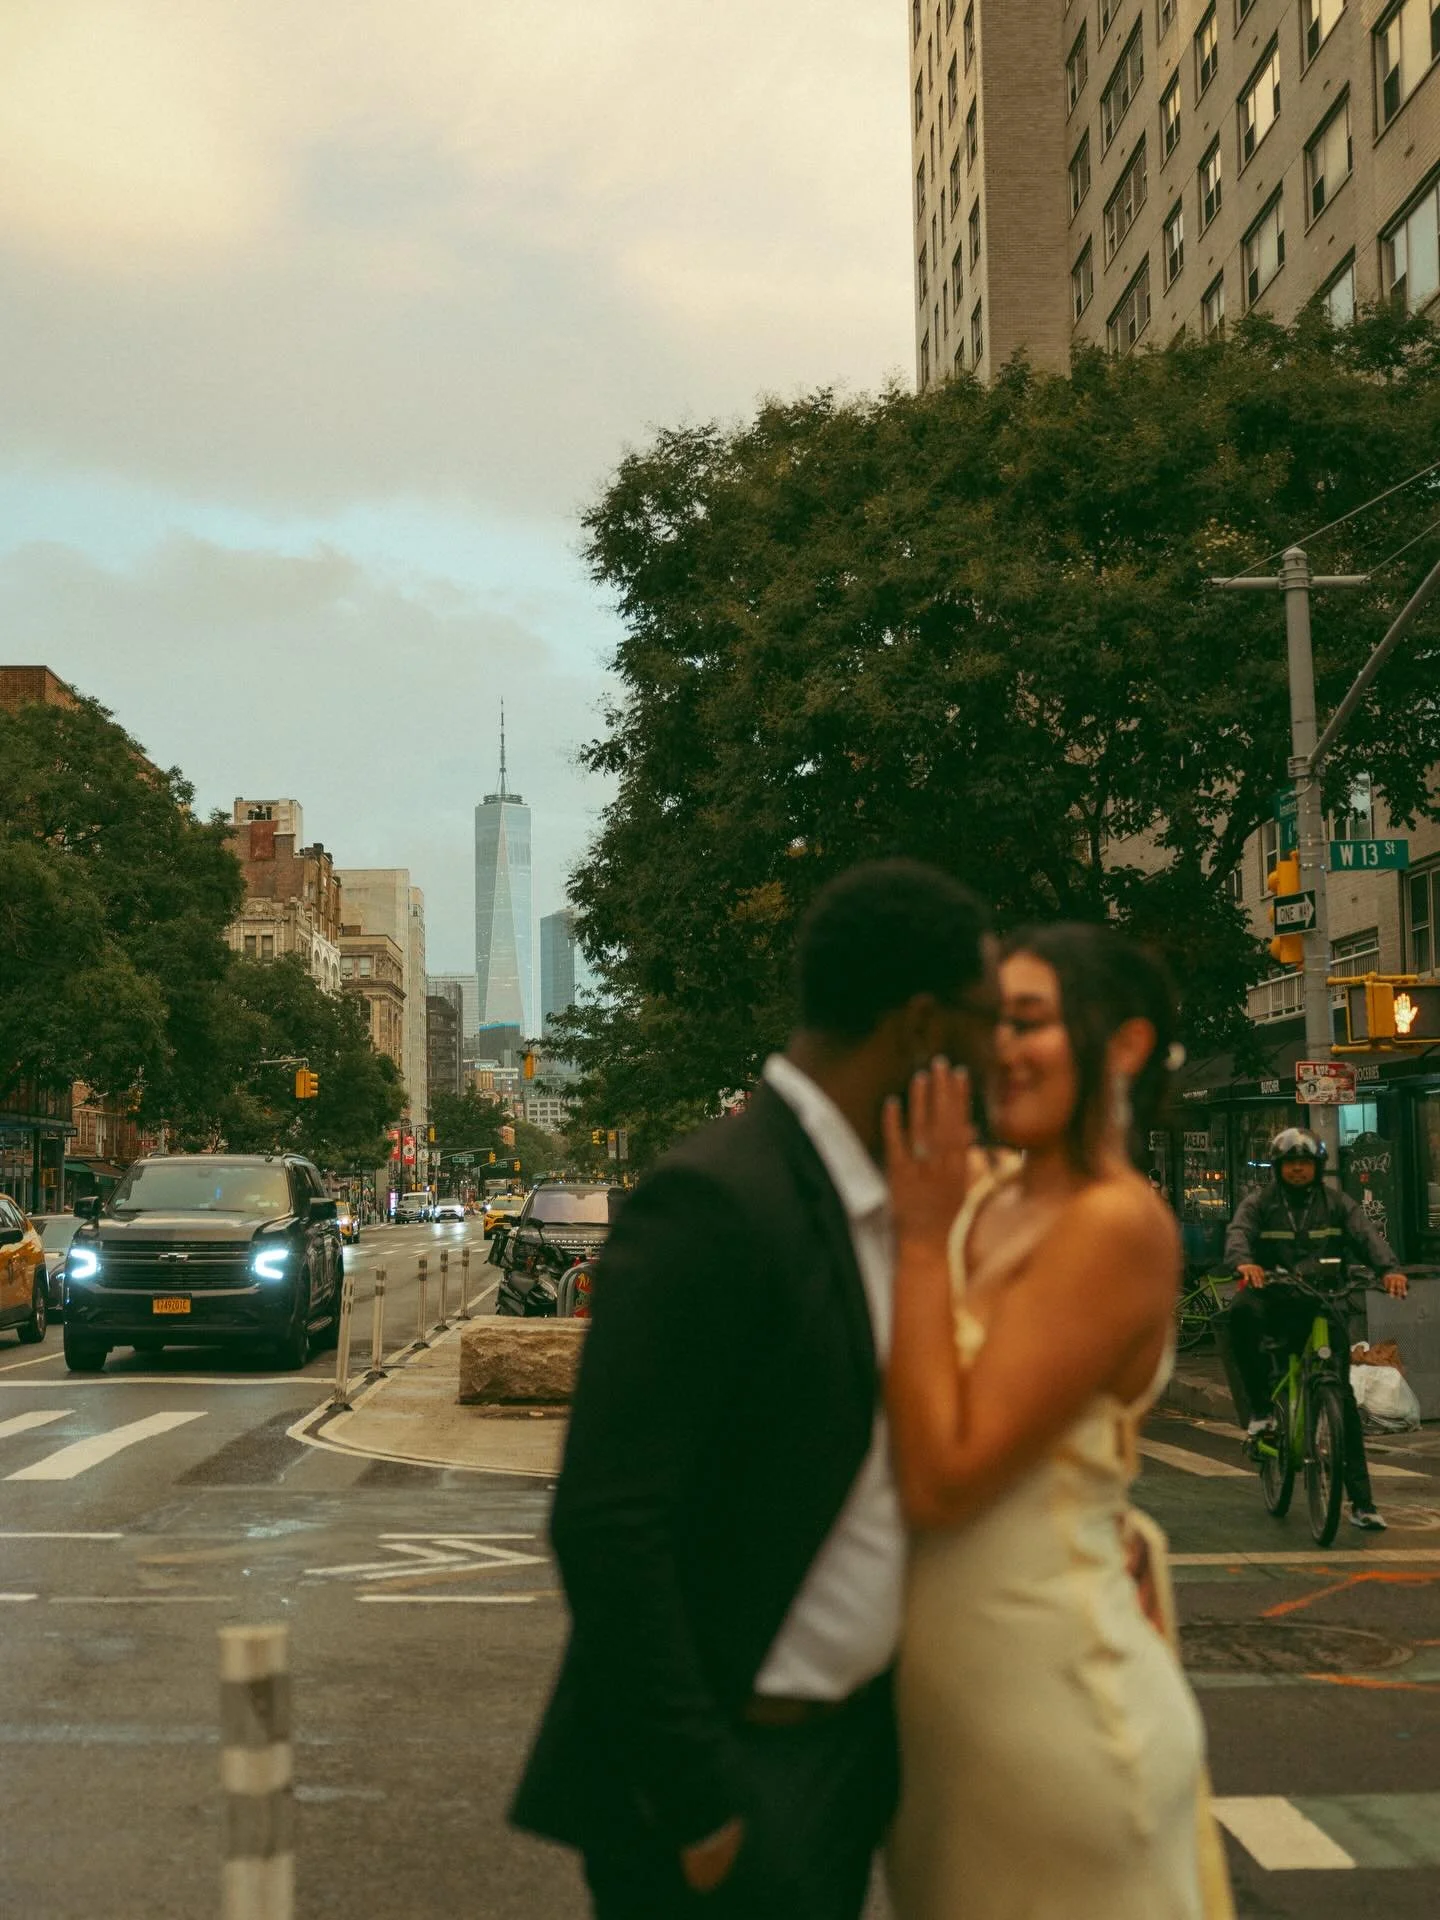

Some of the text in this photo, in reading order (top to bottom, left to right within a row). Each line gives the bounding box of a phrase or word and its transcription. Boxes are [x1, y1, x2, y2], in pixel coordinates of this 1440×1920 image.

[1340, 841, 1396, 867] W 13 St
[1280, 903, 1311, 923] ONE WAY
